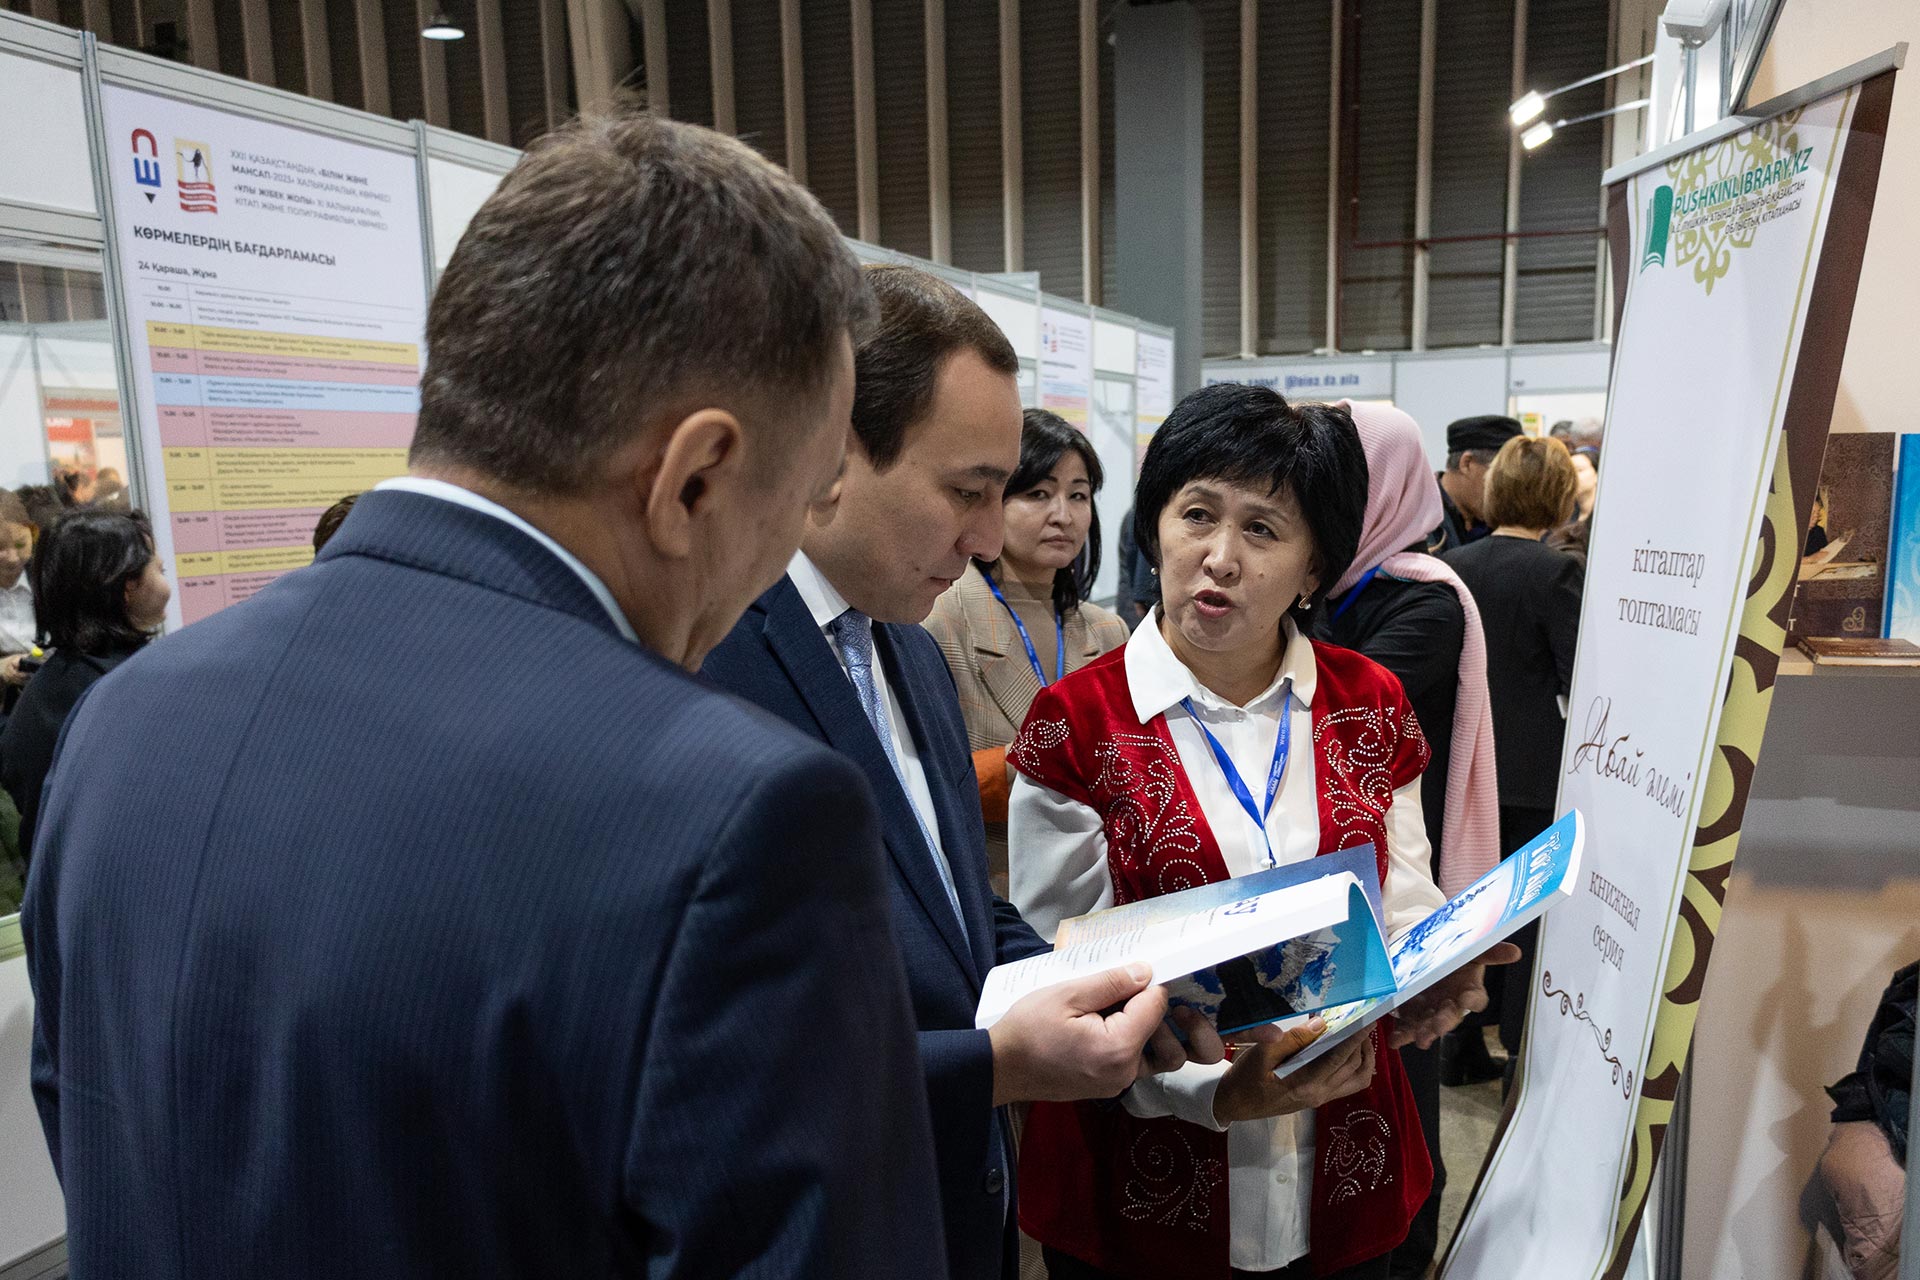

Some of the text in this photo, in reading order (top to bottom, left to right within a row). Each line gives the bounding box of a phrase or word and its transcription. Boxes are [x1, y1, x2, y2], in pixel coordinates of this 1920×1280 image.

[1674, 147, 1814, 217] PUSHKINLIBRARY.KZ
[133, 225, 337, 266] КӨРМЕЛЕРДІҢ БАҒДАРЛАМАСЫ
[138, 260, 218, 280] 24 Қараша, Жұма
[1632, 539, 1705, 588] кітаптар
[1618, 597, 1702, 636] топтамасы
[1567, 695, 1644, 788] Абай
[1589, 871, 1641, 931] книжная
[1593, 925, 1625, 972] серия
